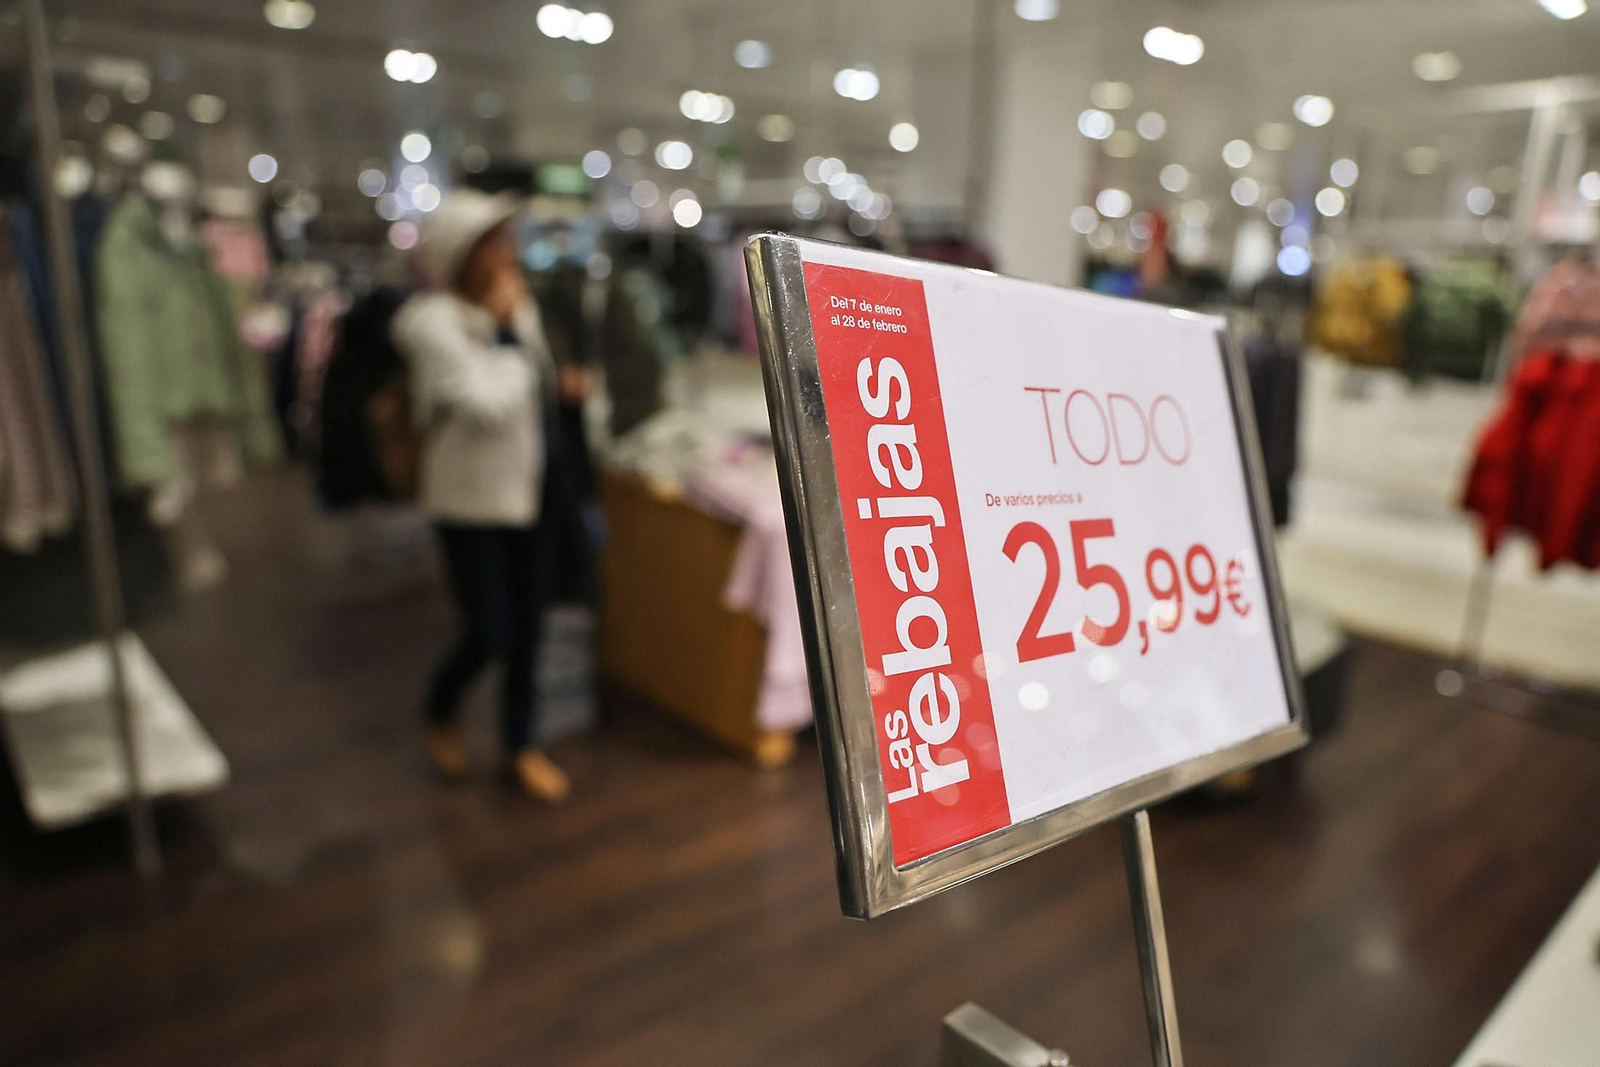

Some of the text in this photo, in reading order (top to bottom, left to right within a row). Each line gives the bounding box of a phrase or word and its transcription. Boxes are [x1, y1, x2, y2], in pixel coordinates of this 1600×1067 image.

[830, 295, 902, 316] Del 7 de enero
[830, 314, 908, 334] al 28 de febrero
[1023, 386, 1193, 467] TODO
[985, 493, 1001, 507] De
[1003, 491, 1035, 506] varios
[1036, 490, 1074, 508] precios
[856, 355, 971, 794] rebajas
[1001, 517, 1252, 664] 25,99€
[885, 708, 920, 804] Las
